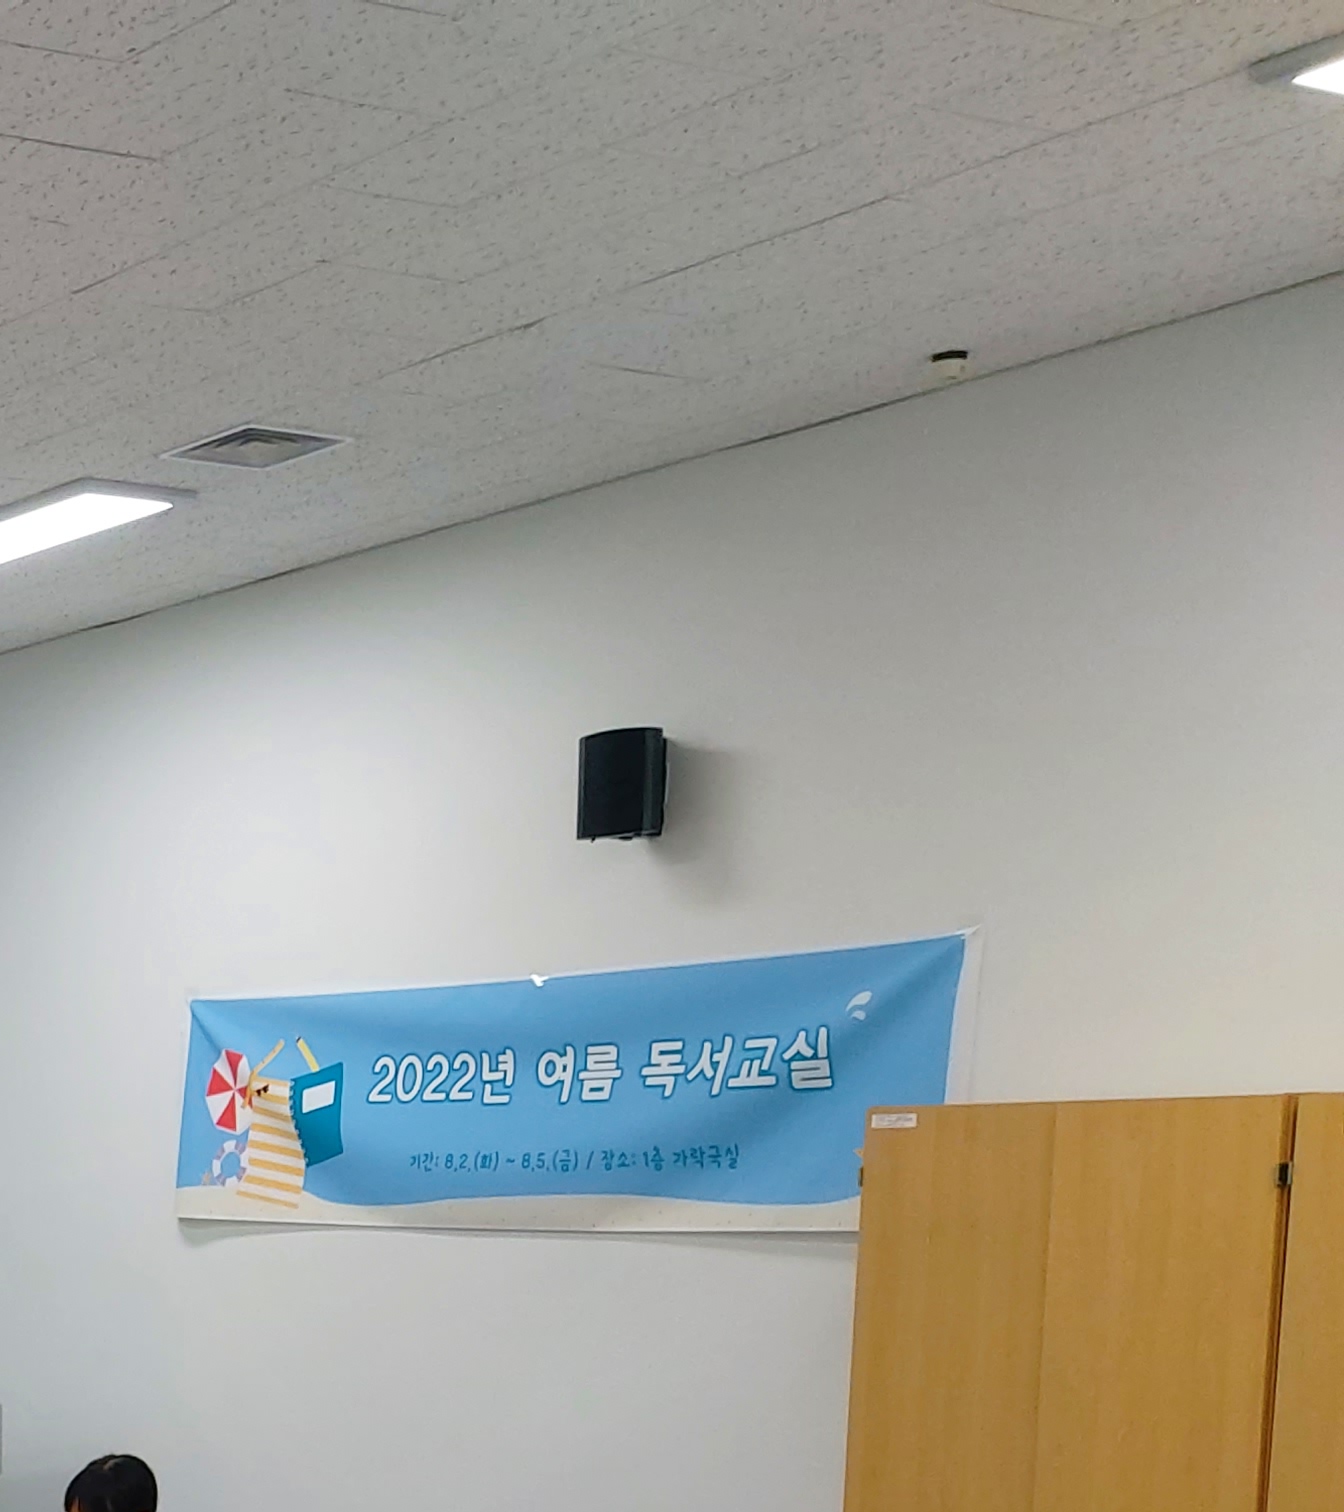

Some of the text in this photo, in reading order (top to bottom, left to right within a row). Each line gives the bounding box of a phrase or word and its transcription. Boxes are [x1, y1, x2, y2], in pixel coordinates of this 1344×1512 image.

[368, 1025, 833, 1105] 2022년 여름 독서교실
[643, 1145, 665, 1168] 1층
